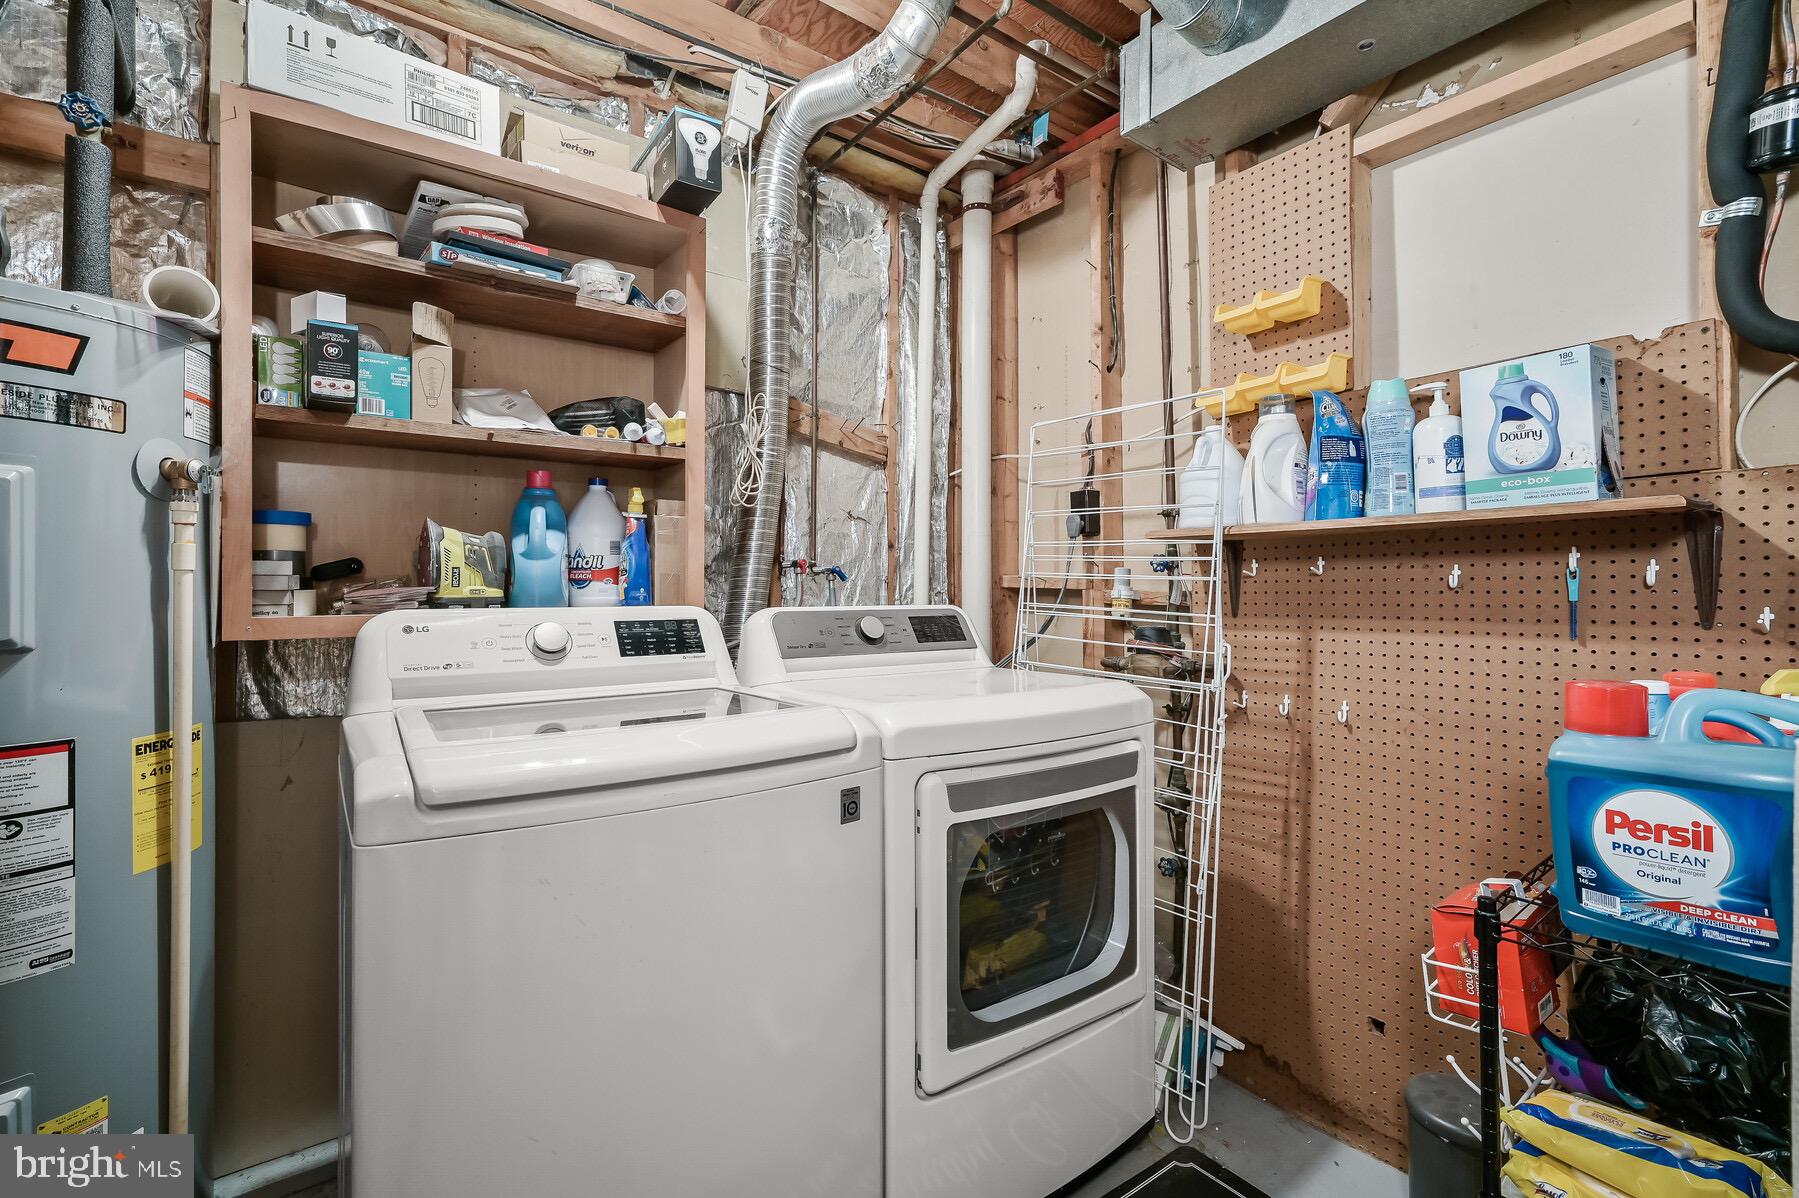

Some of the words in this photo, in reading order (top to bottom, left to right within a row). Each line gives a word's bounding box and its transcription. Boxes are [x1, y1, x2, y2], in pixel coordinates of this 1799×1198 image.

[560, 140, 595, 157] verizon
[440, 249, 459, 261] STP
[259, 336, 267, 352] LED
[1559, 351, 1574, 360] 180
[1500, 429, 1543, 443] Downy
[1501, 475, 1551, 488] eco-box
[452, 567, 460, 588] RYOBI
[149, 764, 172, 778] 419
[1605, 808, 1714, 853] Persil
[1612, 841, 1707, 868] PROCLEAN
[1636, 869, 1681, 885] Original
[1677, 867, 1707, 878] detergent
[1652, 907, 1686, 919] VISIBLE
[1694, 916, 1738, 931] INVISIBLE
[1740, 925, 1761, 935] DIRT
[1680, 904, 1712, 916] DEEP
[1714, 911, 1757, 927] CLEAN
